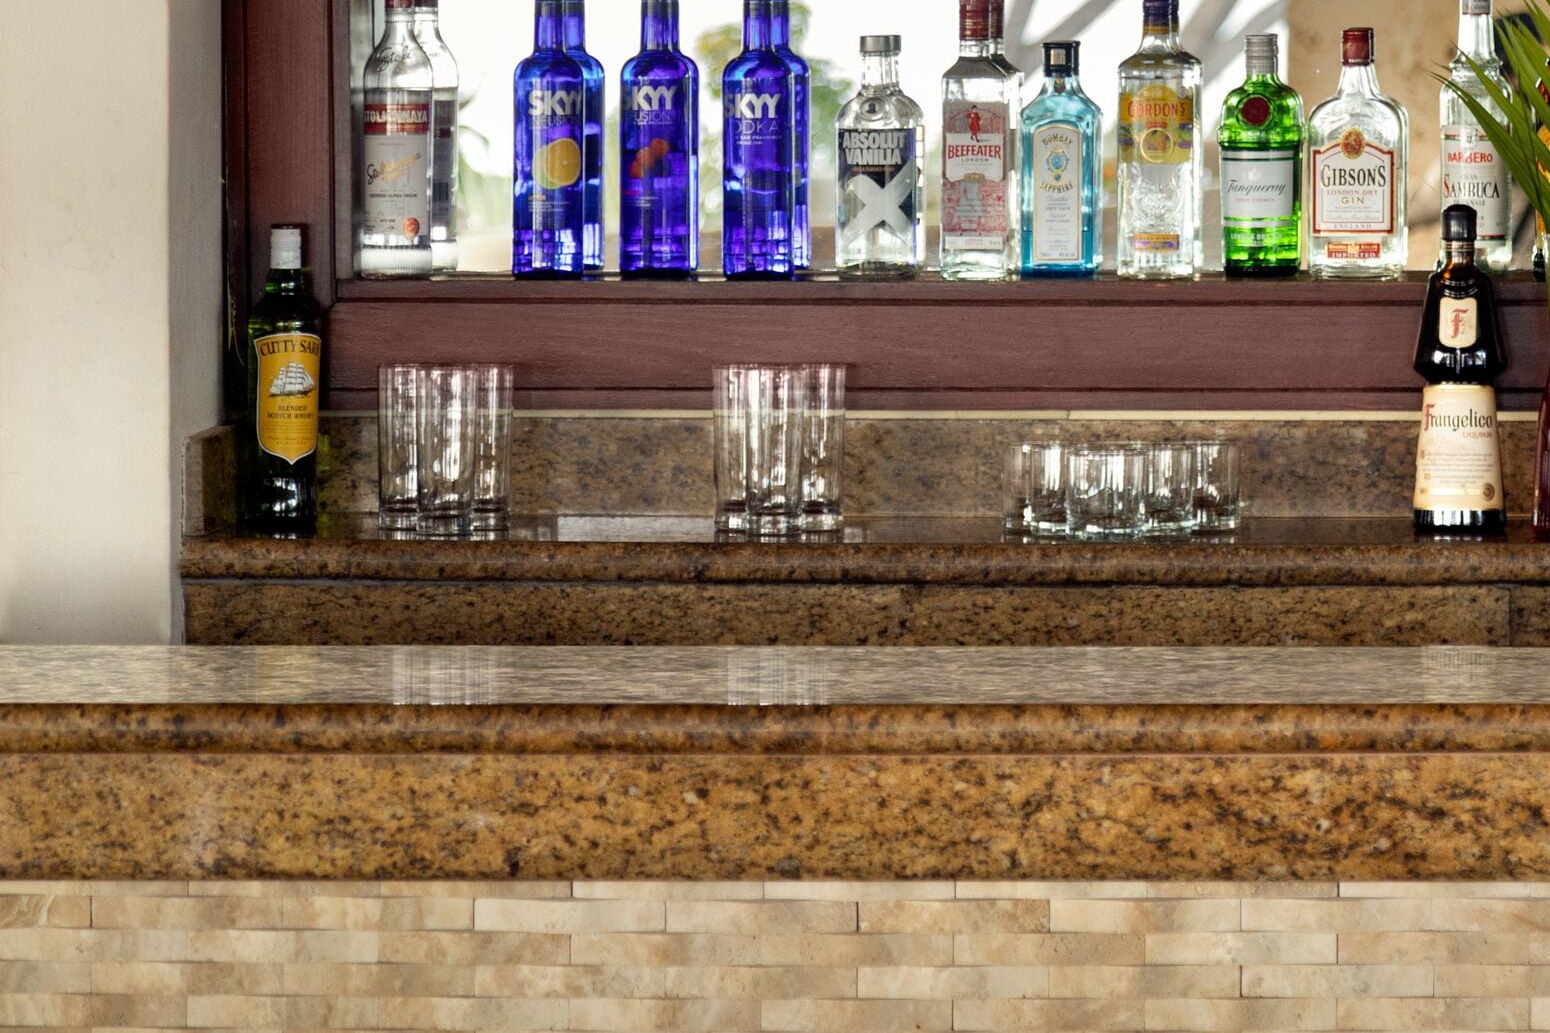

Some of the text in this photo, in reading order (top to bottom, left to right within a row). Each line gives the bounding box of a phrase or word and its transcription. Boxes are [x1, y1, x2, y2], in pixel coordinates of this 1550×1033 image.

[724, 93, 781, 118] SKYY
[843, 131, 905, 148] ABSOLUT
[1041, 133, 1073, 146] BOMBAY
[845, 148, 902, 166] VANILIA
[947, 144, 1002, 160] BEEFEATER
[1447, 152, 1493, 164] BARBERO
[1321, 164, 1387, 188] GIBSON'S
[1226, 178, 1287, 196] Tanqueray
[1443, 174, 1500, 199] SAMBUCA
[1341, 196, 1365, 205] GIN
[1451, 308, 1469, 339] F
[260, 339, 297, 357] CUTTY
[1424, 403, 1493, 432] Frangelico
